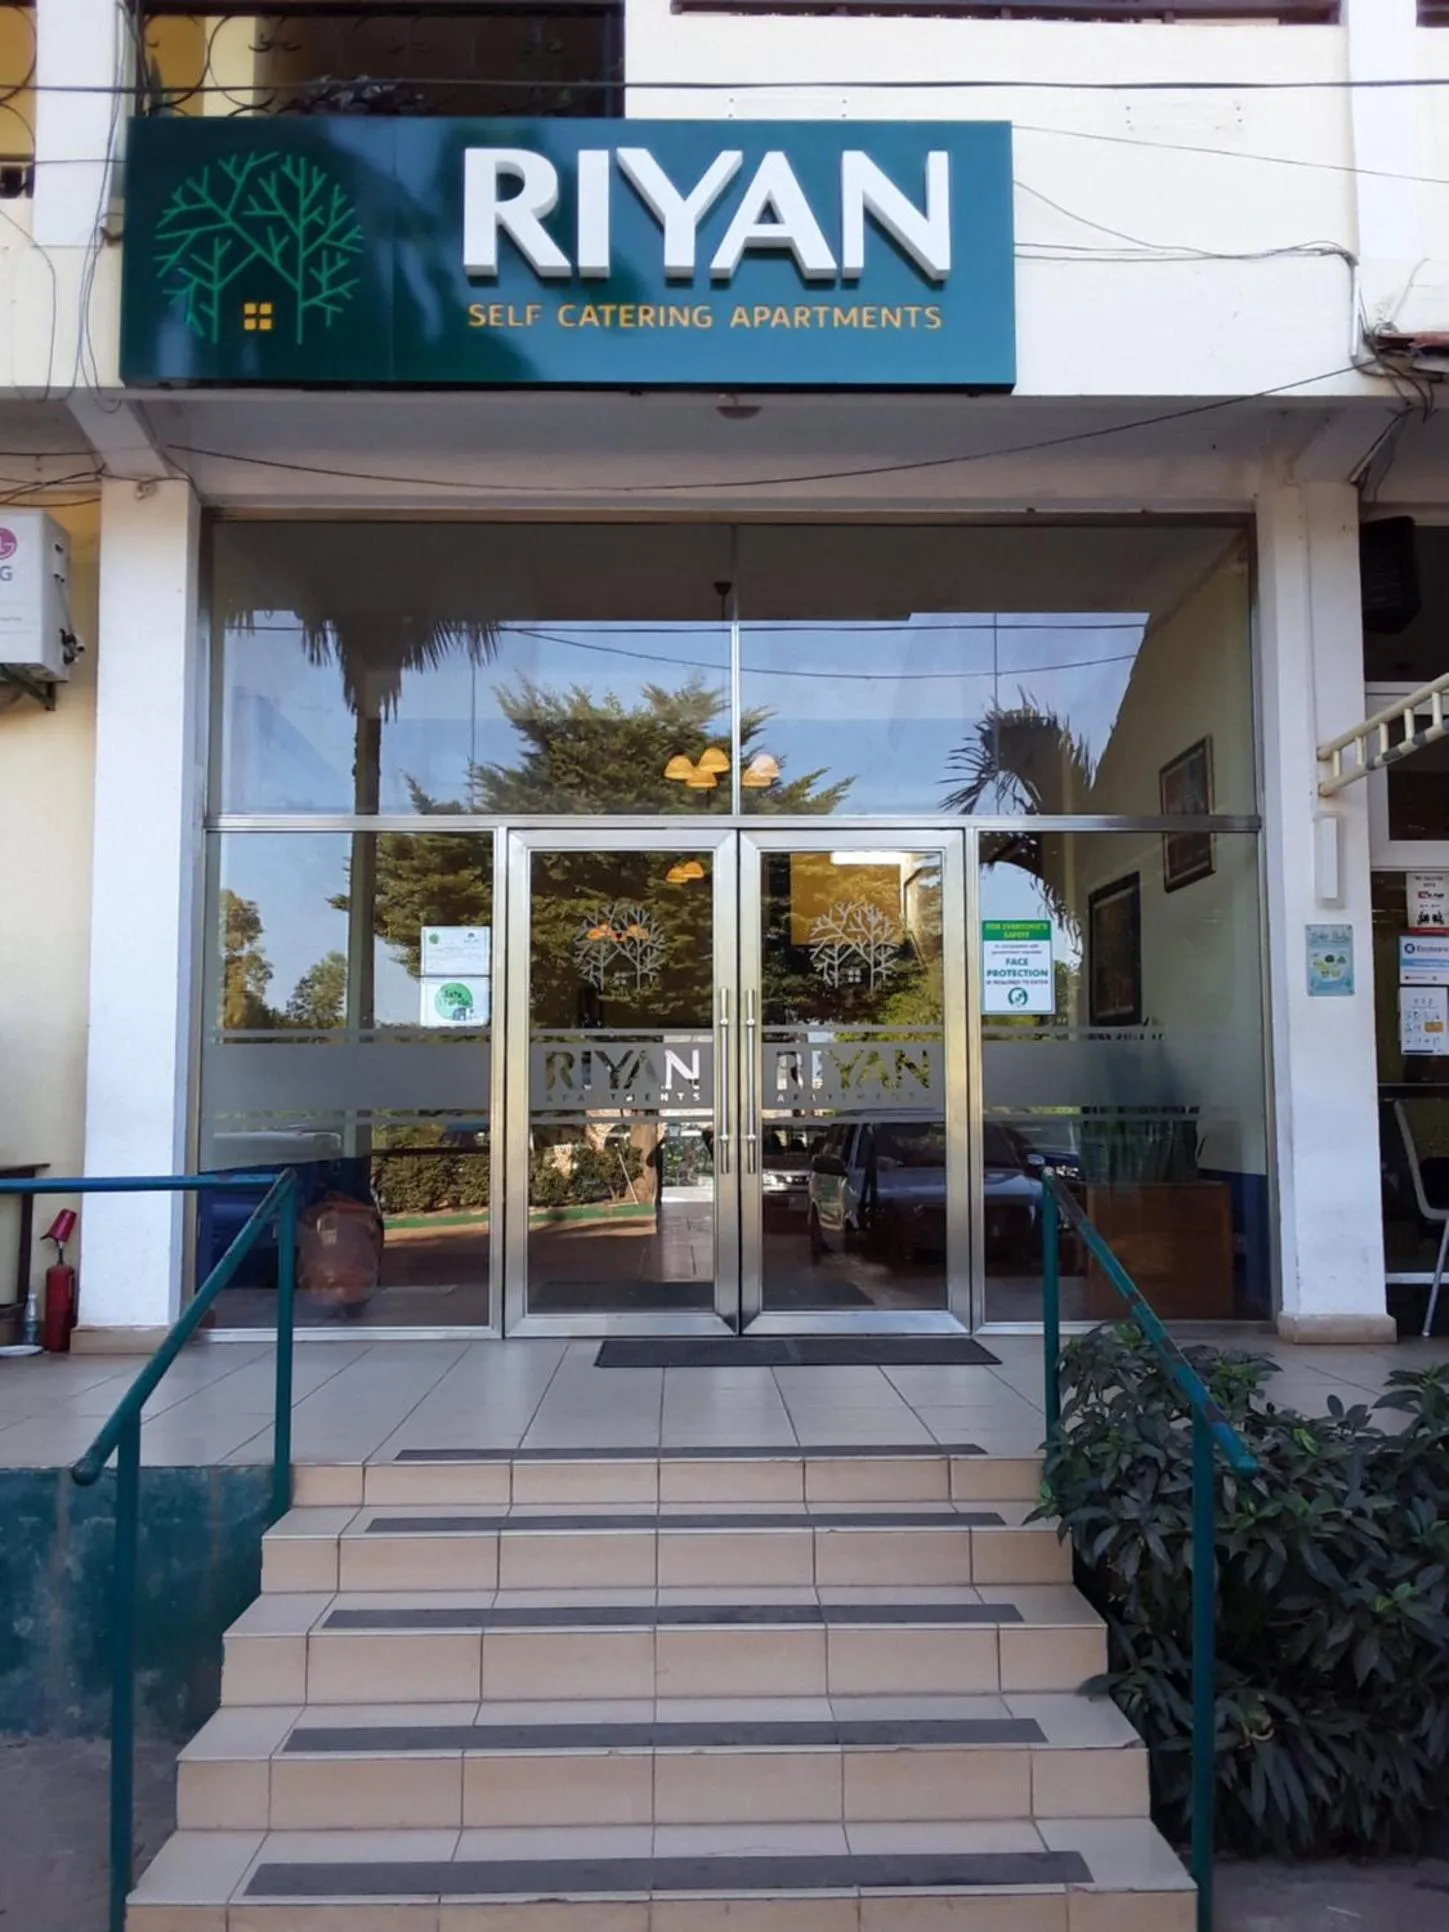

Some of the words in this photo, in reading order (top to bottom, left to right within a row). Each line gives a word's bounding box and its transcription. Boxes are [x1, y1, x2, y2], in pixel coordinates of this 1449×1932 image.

[463, 147, 951, 280] RIYAN
[468, 304, 540, 328] SELF
[557, 304, 713, 329] CATERING
[730, 305, 942, 330] APARTMENTS
[986, 969, 1048, 977] PROTECTION
[1005, 957, 1028, 966] FACE
[545, 1049, 700, 1091] RIYAN
[776, 1049, 930, 1091] RIYAN
[546, 1092, 701, 1102] APATMENTS
